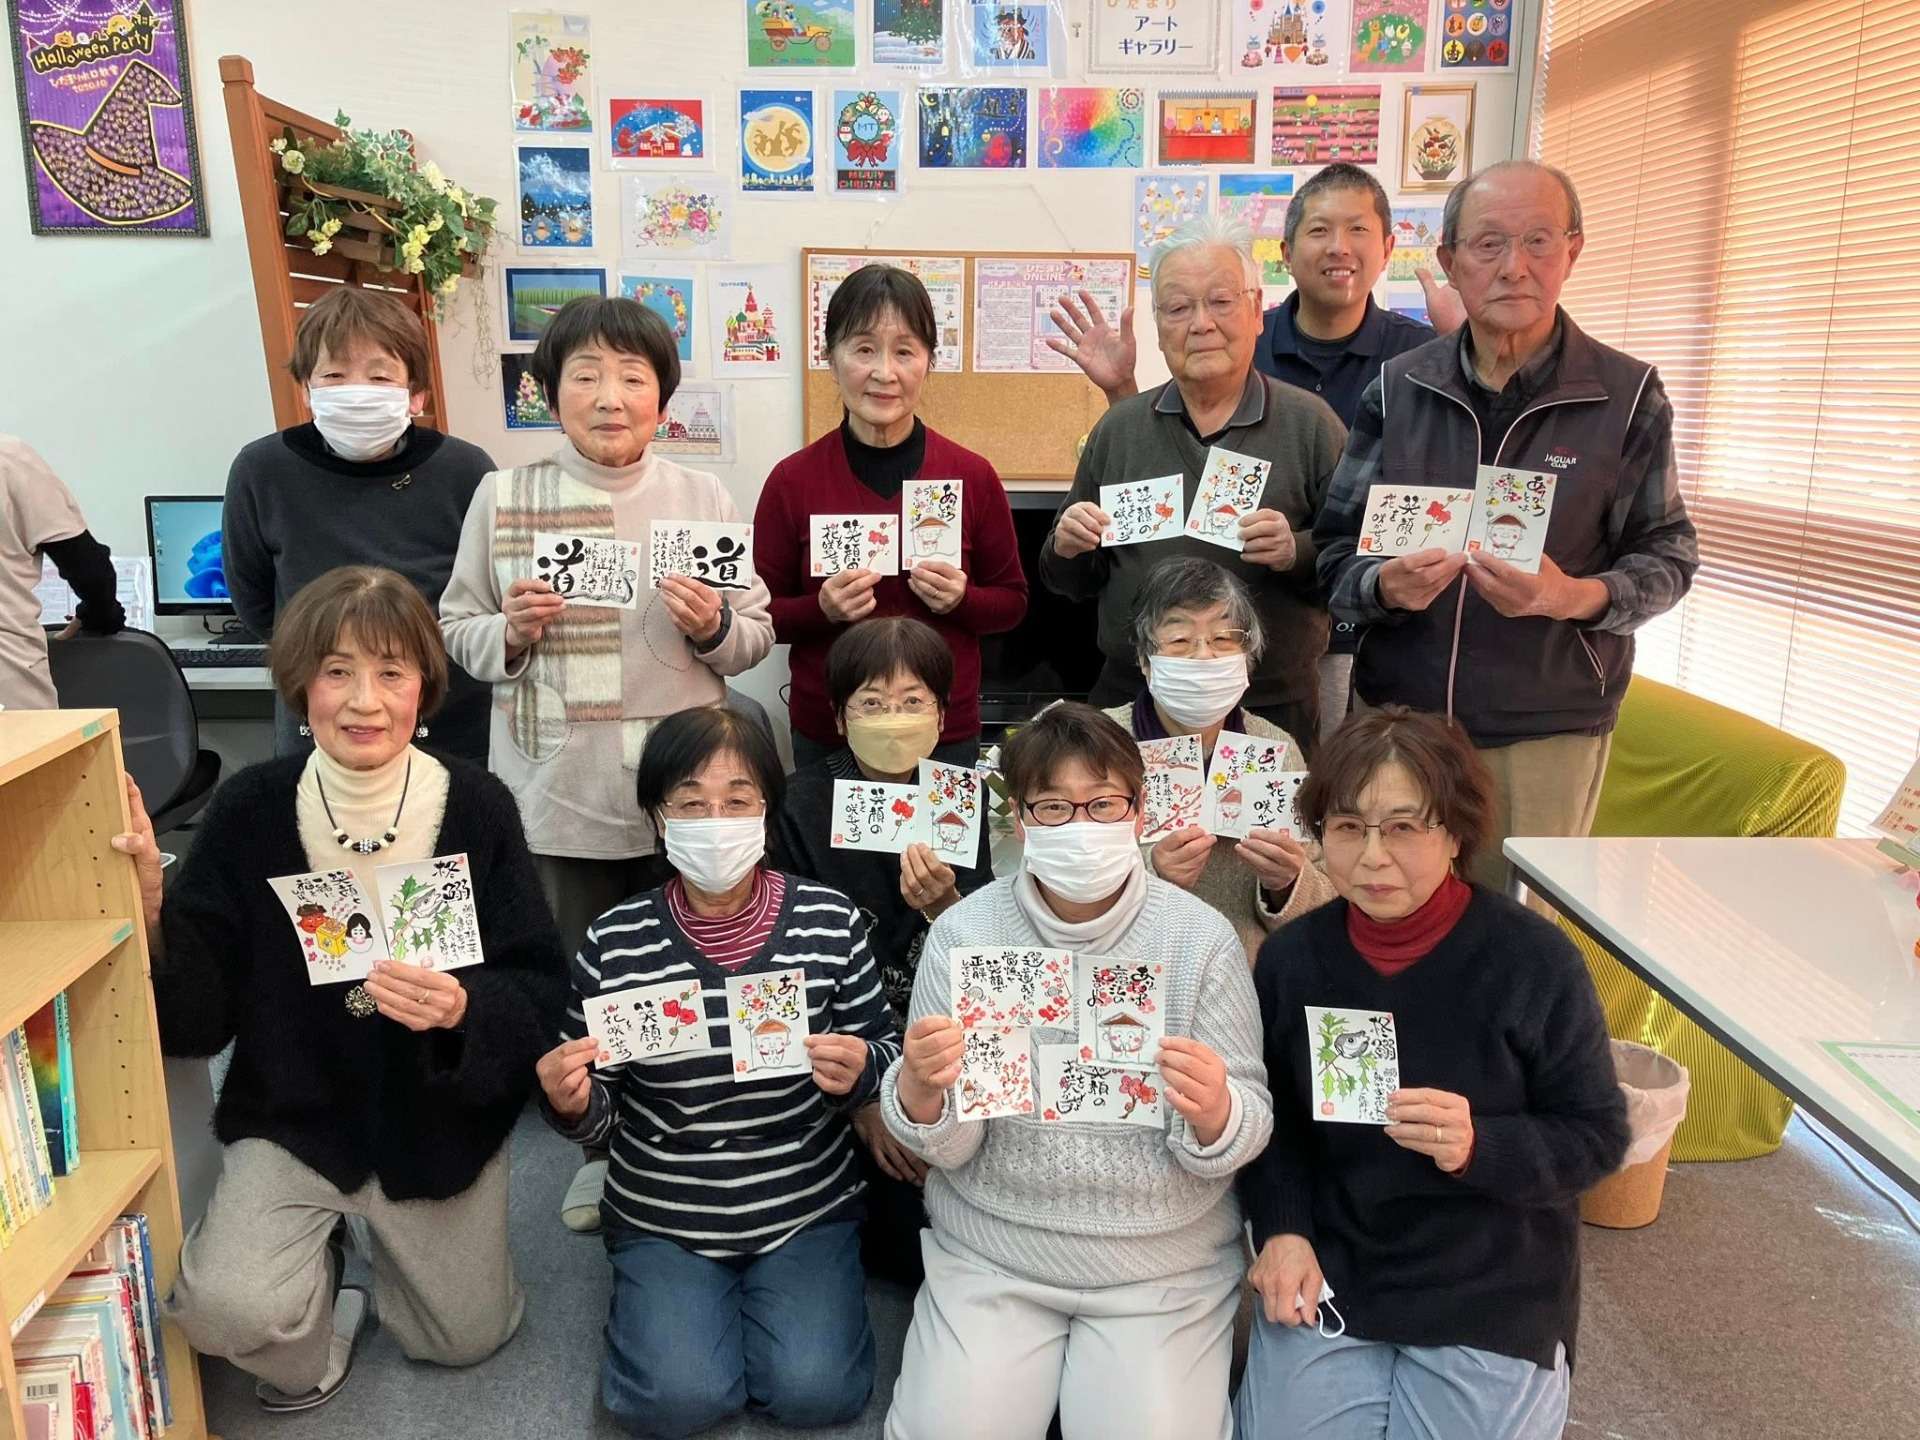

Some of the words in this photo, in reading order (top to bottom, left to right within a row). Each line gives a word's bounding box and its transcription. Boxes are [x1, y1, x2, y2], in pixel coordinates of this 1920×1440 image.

[1135, 16, 1177, 32] アート
[34, 43, 110, 69] Halloween
[113, 30, 149, 51] Party
[1118, 38, 1193, 55] ギャラリー
[1023, 273, 1066, 281] ONLINE
[1544, 453, 1577, 465] JAGUAR
